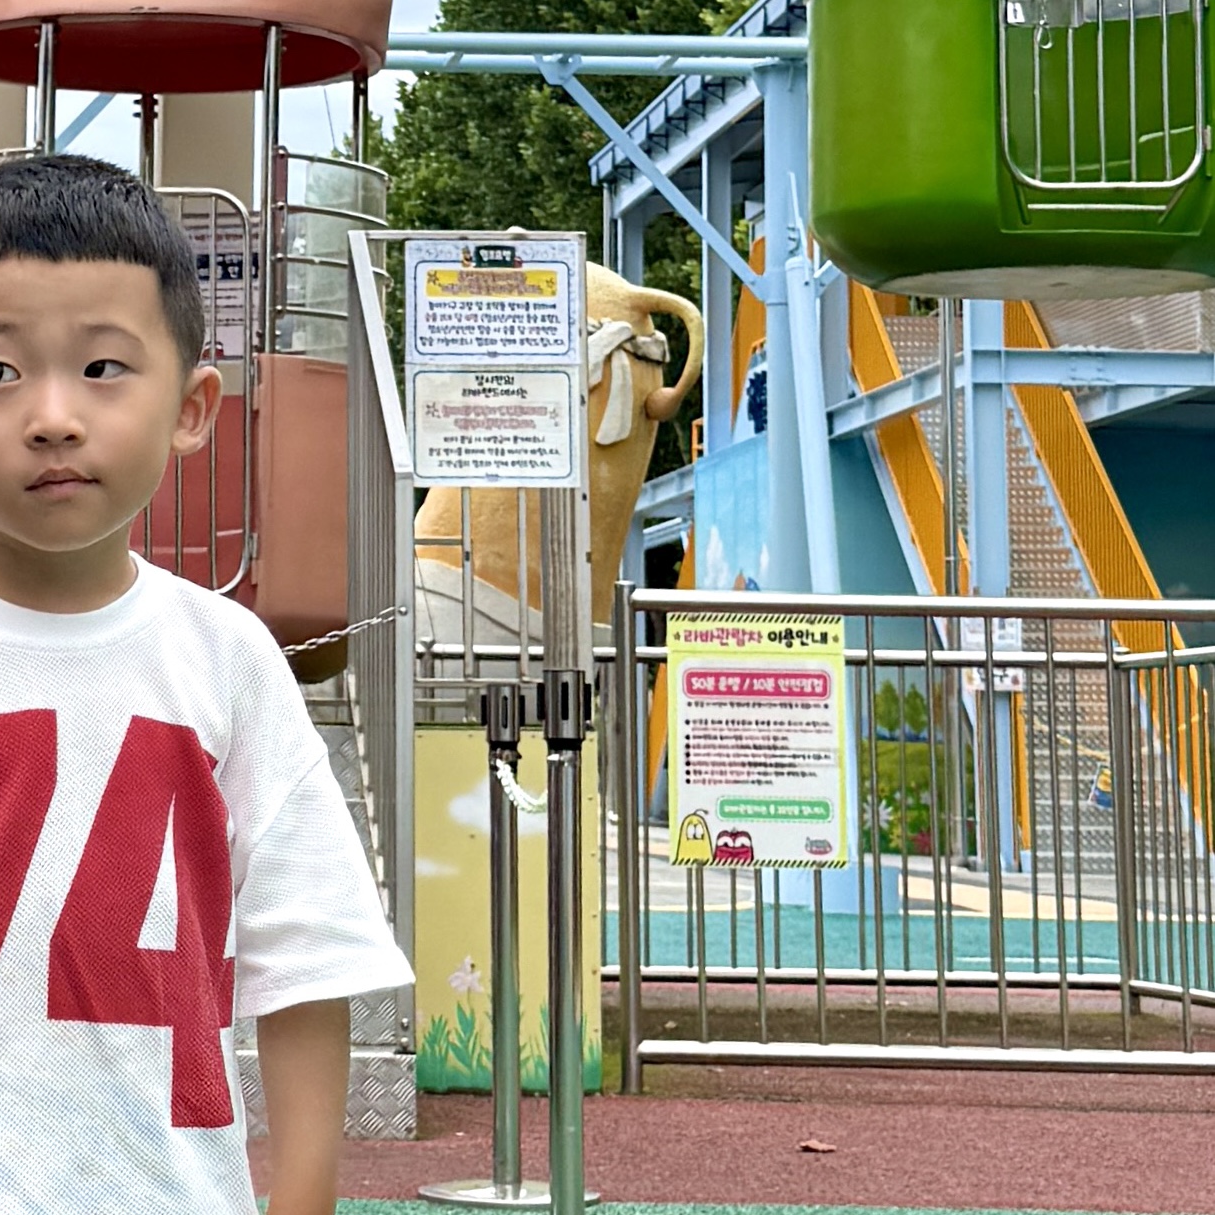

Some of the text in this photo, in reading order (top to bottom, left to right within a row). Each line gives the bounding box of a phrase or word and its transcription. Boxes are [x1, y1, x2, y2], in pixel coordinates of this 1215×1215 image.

[683, 627, 829, 648] 라바관람차 이용안내
[718, 676, 741, 692] 운행
[777, 678, 824, 693] 안전점검
